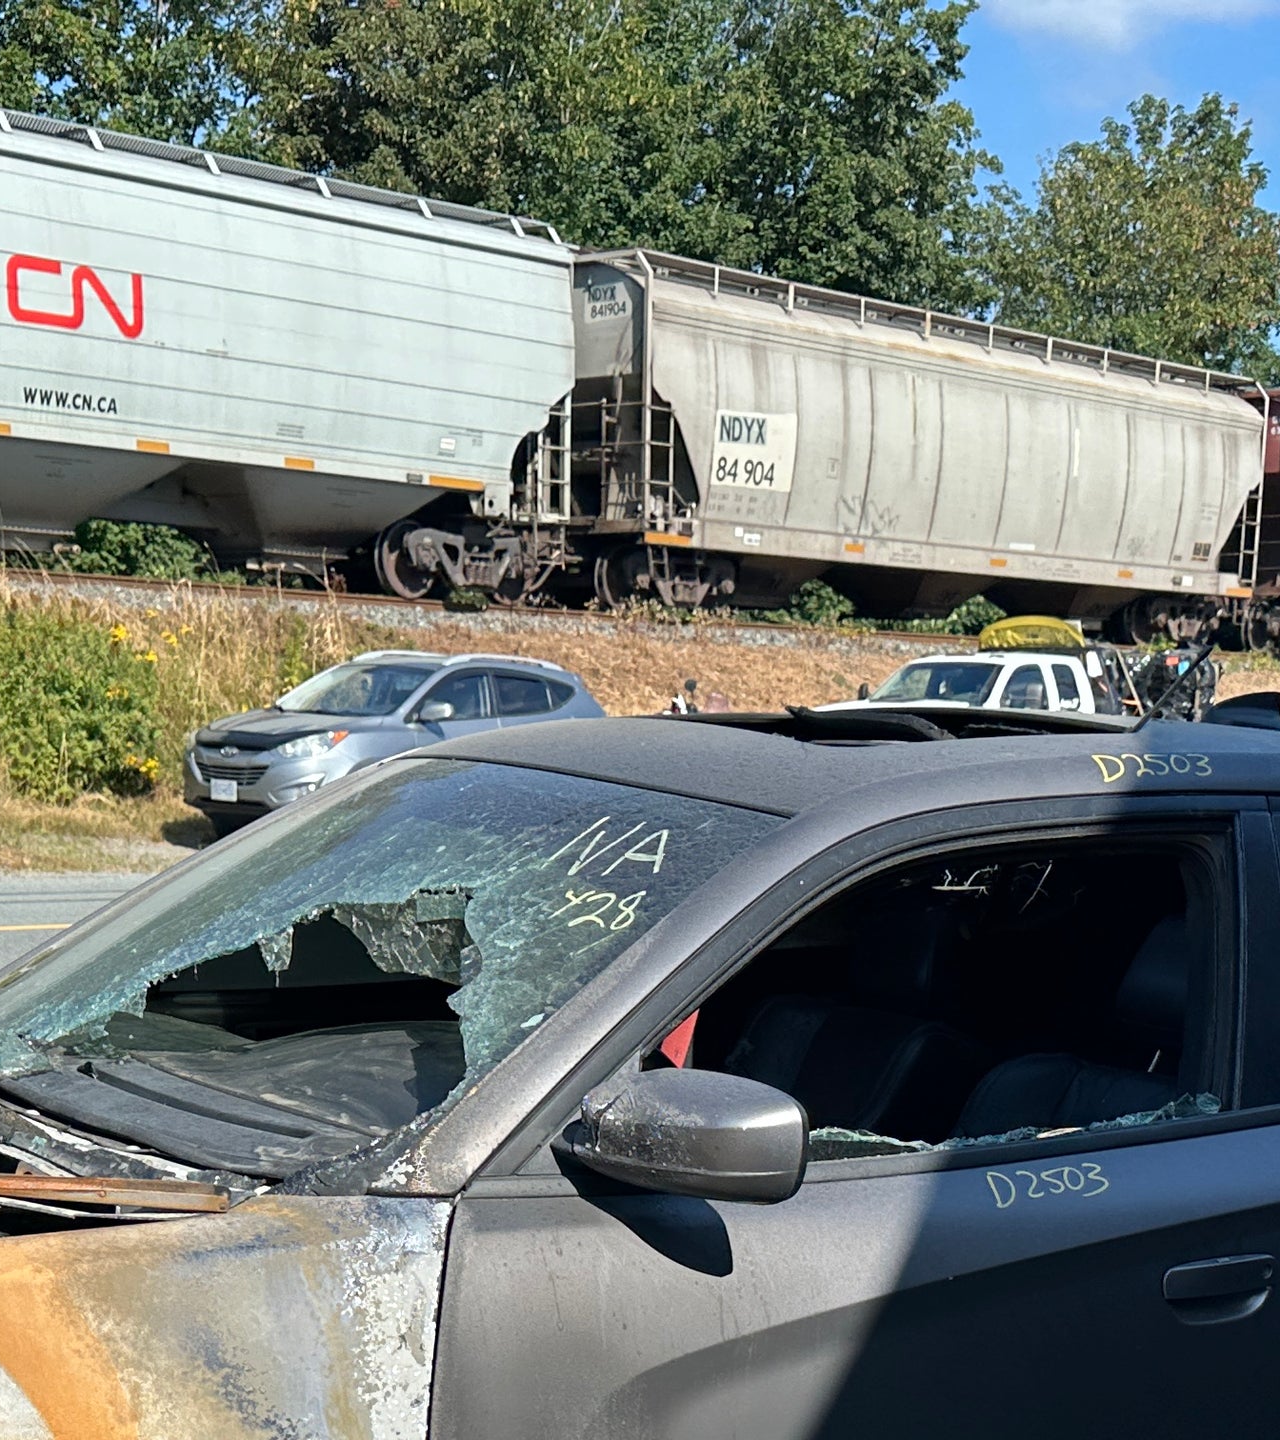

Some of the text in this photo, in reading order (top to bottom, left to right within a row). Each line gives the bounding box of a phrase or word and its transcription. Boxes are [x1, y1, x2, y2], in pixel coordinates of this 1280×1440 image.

[6, 253, 143, 339] CN
[23, 386, 118, 414] WWW.CN.CA
[720, 415, 766, 445] NDYX
[1091, 753, 1213, 783] D2503
[986, 1162, 1110, 1209] D2503
